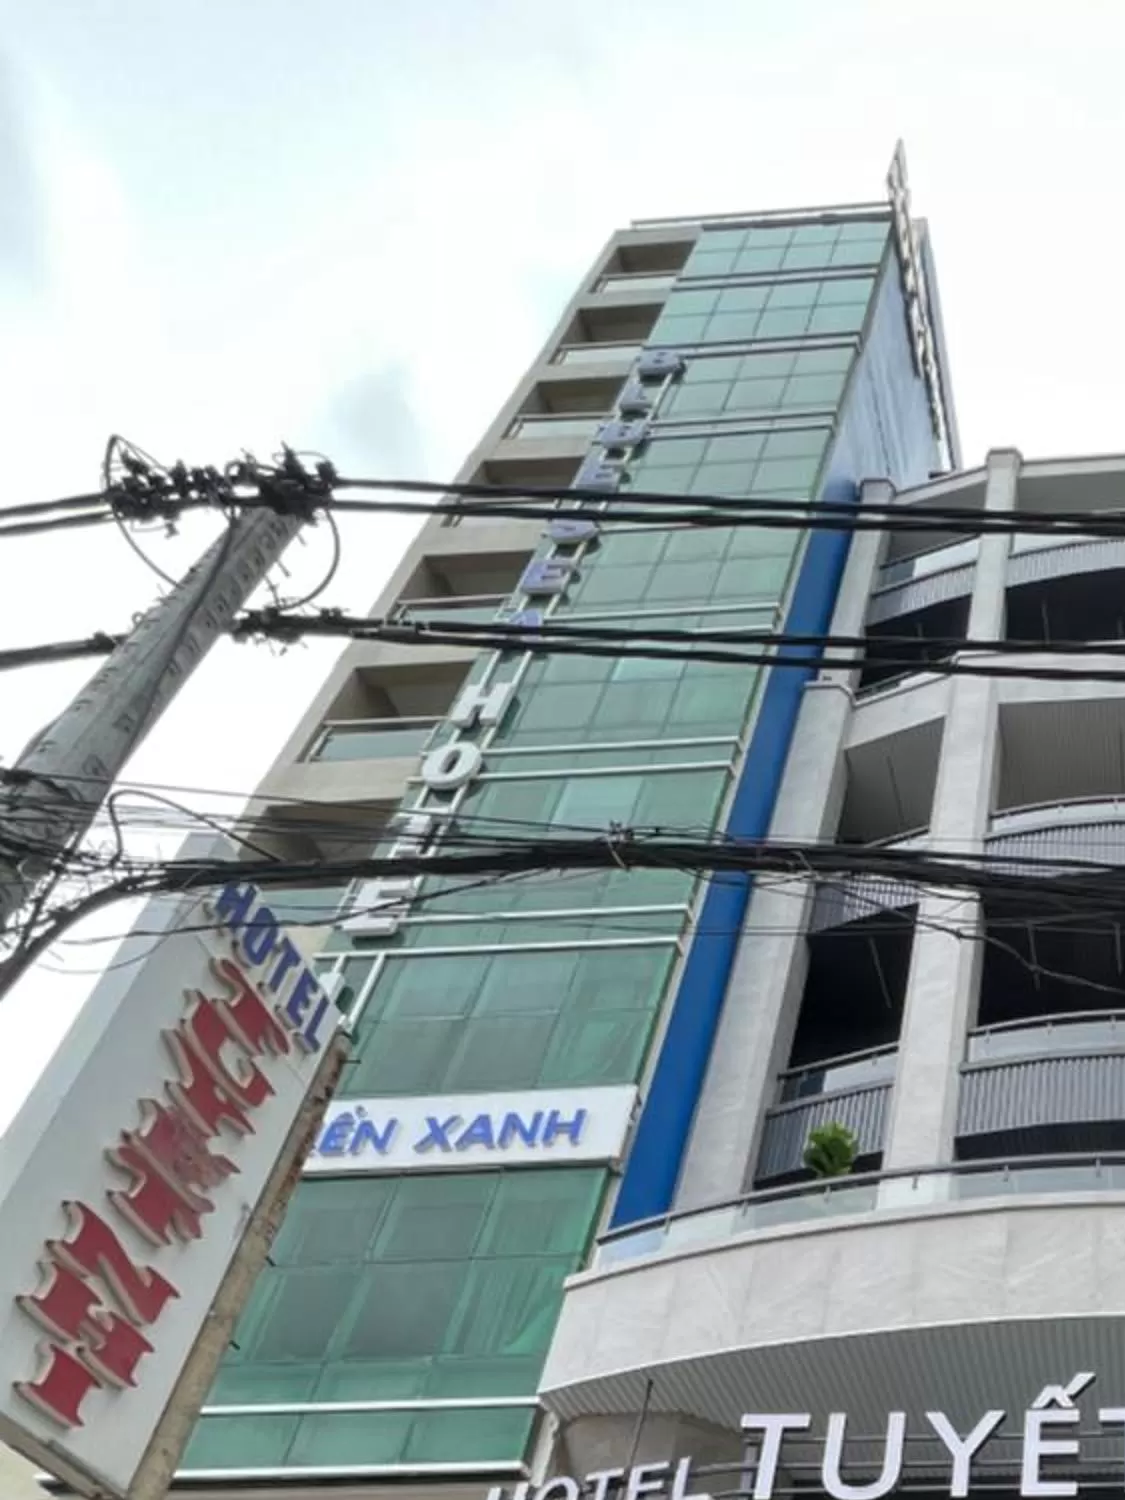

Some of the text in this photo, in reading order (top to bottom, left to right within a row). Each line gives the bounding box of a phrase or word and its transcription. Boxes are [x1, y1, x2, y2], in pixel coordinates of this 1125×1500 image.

[215, 880, 331, 1053] HOTEL
[413, 1108, 587, 1154] XANH
[14, 1200, 181, 1428] NHI
